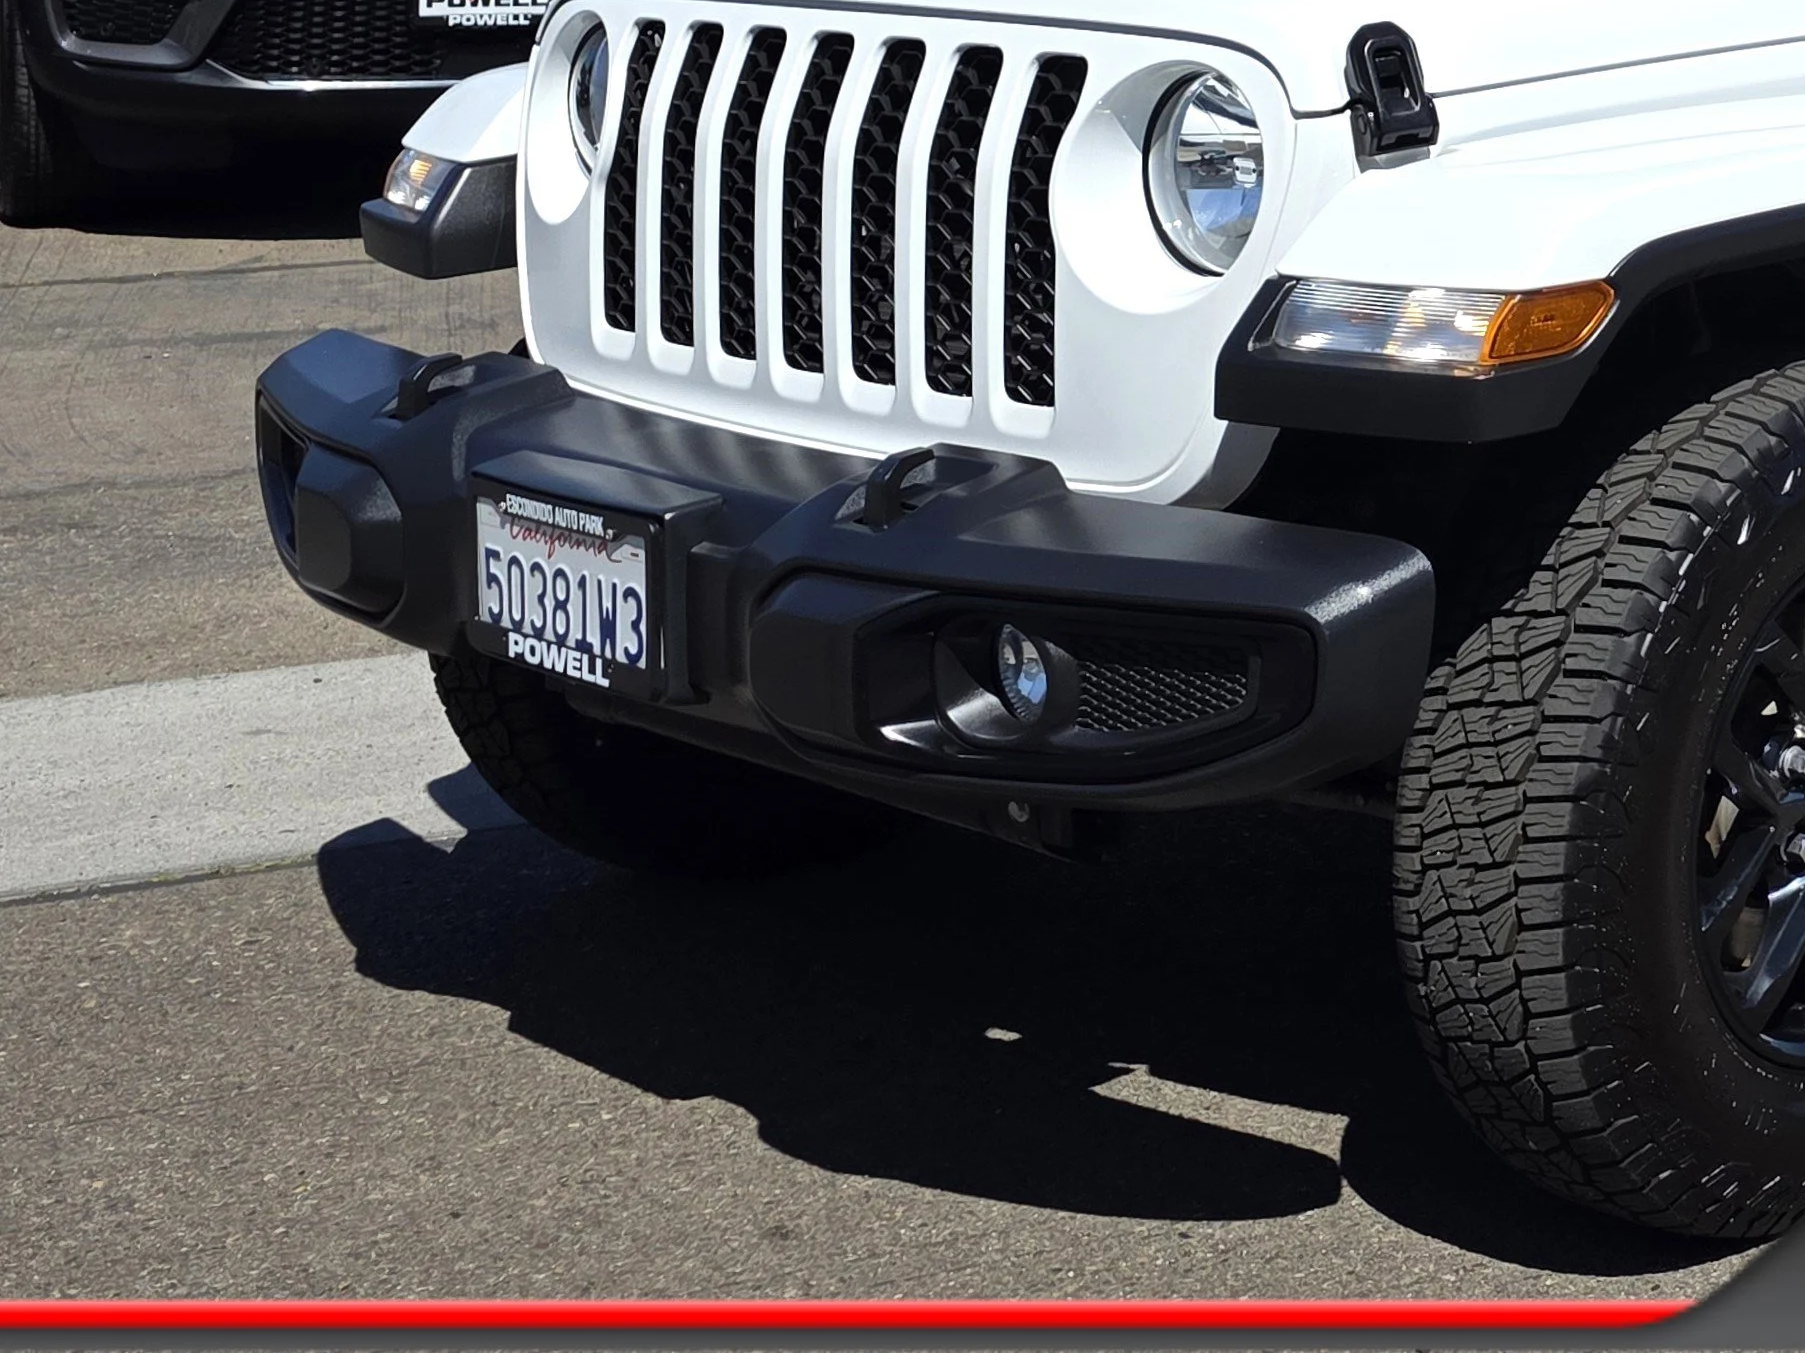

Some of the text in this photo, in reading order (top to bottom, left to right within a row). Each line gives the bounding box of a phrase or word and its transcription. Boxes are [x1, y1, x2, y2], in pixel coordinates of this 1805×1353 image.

[448, 14, 530, 27] POWELL
[506, 493, 605, 537] ESCONDIDO AUTO PARK
[508, 517, 622, 563] California
[484, 546, 644, 665] 50381W3
[508, 631, 610, 688] POWELL
